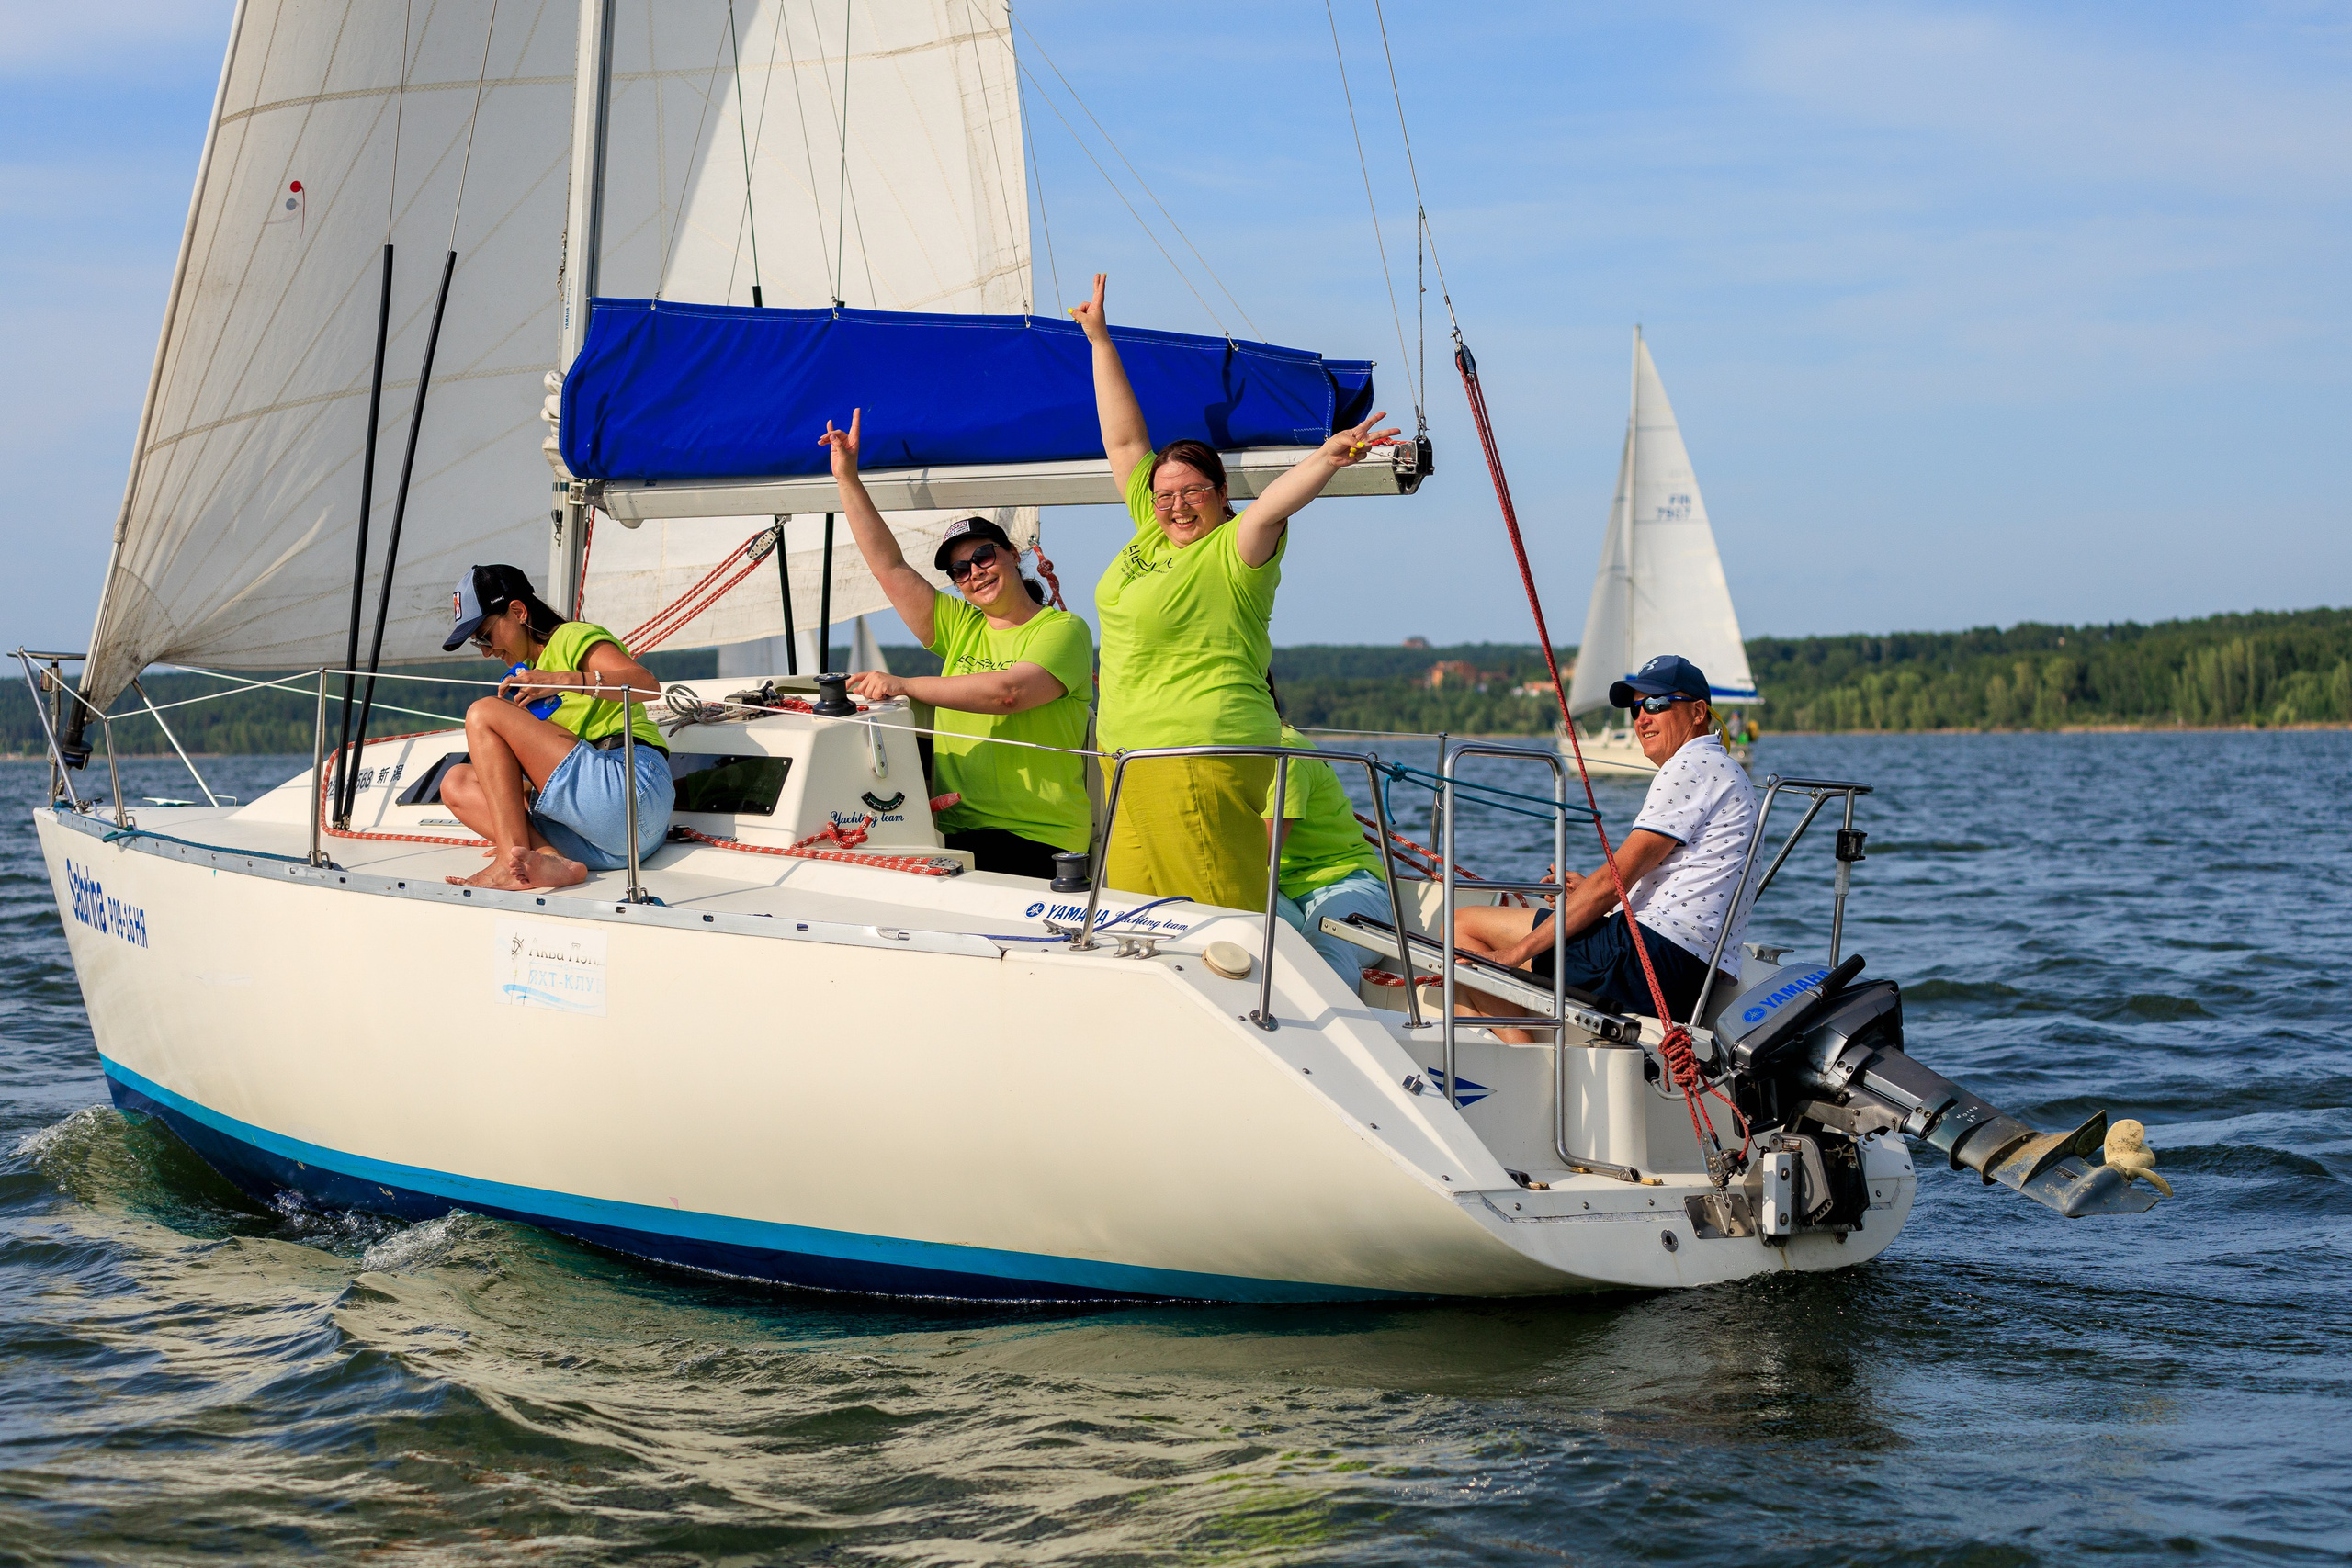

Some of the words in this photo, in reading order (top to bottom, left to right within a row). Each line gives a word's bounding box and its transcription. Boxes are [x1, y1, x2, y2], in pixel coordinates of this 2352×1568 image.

[831, 810, 878, 828] Yachtig
[881, 810, 904, 822] team
[66, 857, 108, 934] Sabrina
[1046, 904, 1110, 925] YAMAA
[1162, 919, 1189, 931] team
[1759, 970, 1830, 1009] YAMAHA
